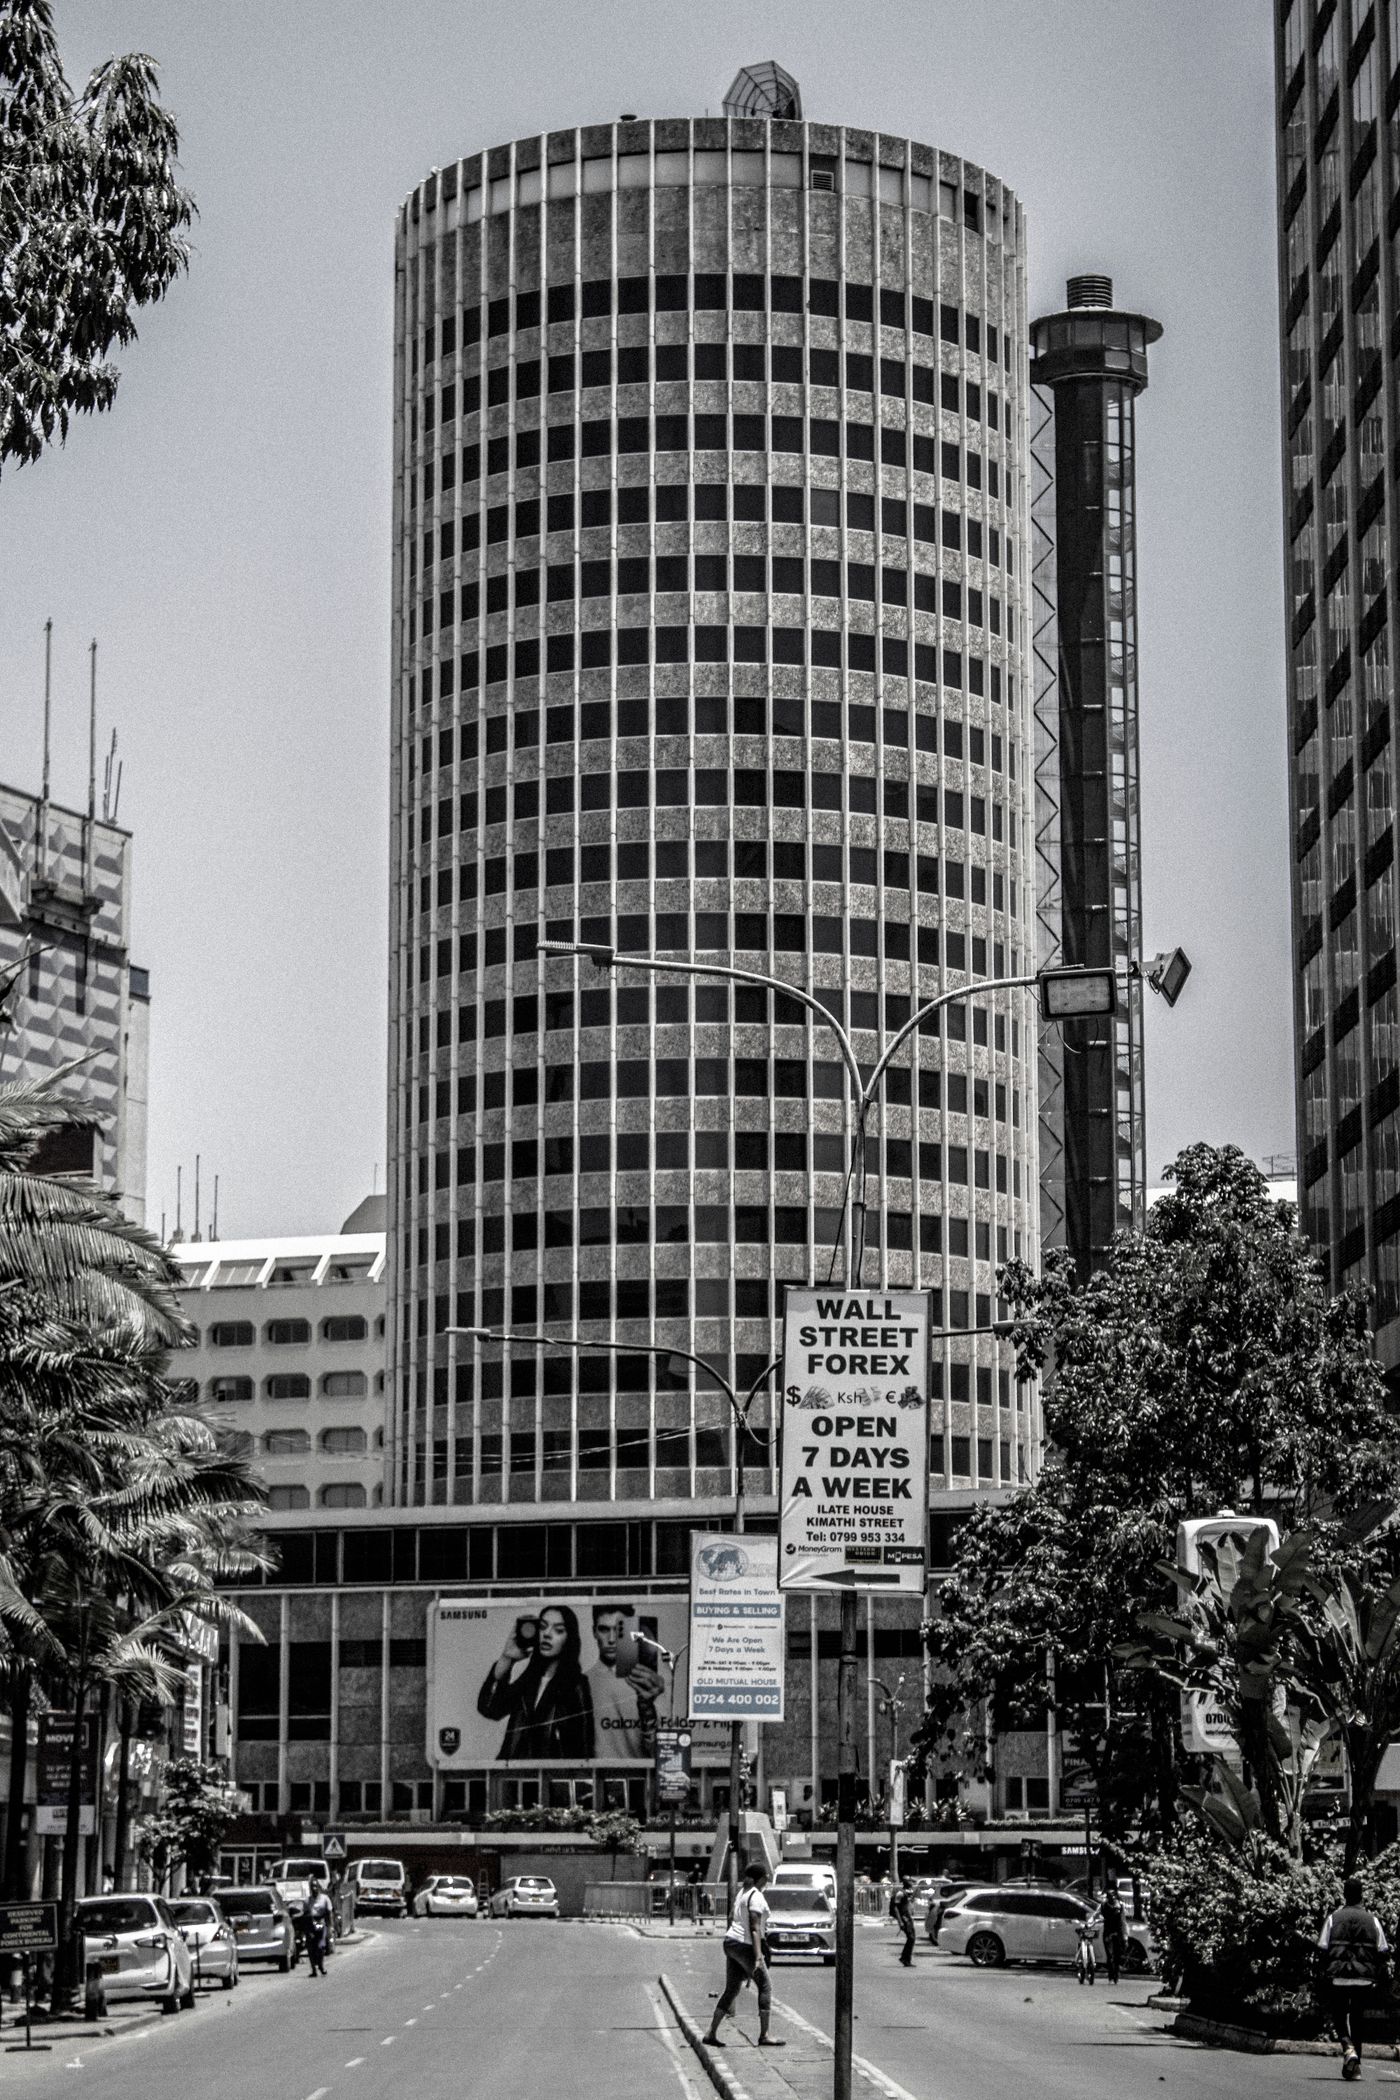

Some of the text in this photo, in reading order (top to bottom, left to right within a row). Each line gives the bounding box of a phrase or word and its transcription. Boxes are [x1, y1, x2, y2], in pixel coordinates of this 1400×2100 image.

[817, 1299, 901, 1320] WALL
[799, 1327, 918, 1348] STREET
[808, 1355, 909, 1375] FOREX
[786, 1386, 896, 1407] $ Ksh €
[811, 1417, 896, 1437] OPEN
[802, 1447, 910, 1468] 7 DAYS
[792, 1477, 912, 1499] A WEEK
[817, 1505, 894, 1515] ILATE HOUSE
[807, 1517, 904, 1528] KIMATHI STREET
[806, 1531, 905, 1543] Tel: 0799 953 334
[798, 1545, 842, 1554] MoneyGram
[719, 1588, 741, 1596] Rates
[754, 1588, 776, 1596] Town
[440, 1610, 487, 1620] SAMSUNG
[696, 1606, 730, 1614] BUYING
[743, 1607, 777, 1615] SELLING
[742, 1637, 763, 1645] Open
[715, 1646, 734, 1654] Days
[694, 1694, 779, 1704] 0724 400 002
[7, 1909, 44, 1918] RESERVED
[2, 1930, 49, 1939] CONTINENTAL
[0, 1937, 53, 1947] FOREX BUREAU
